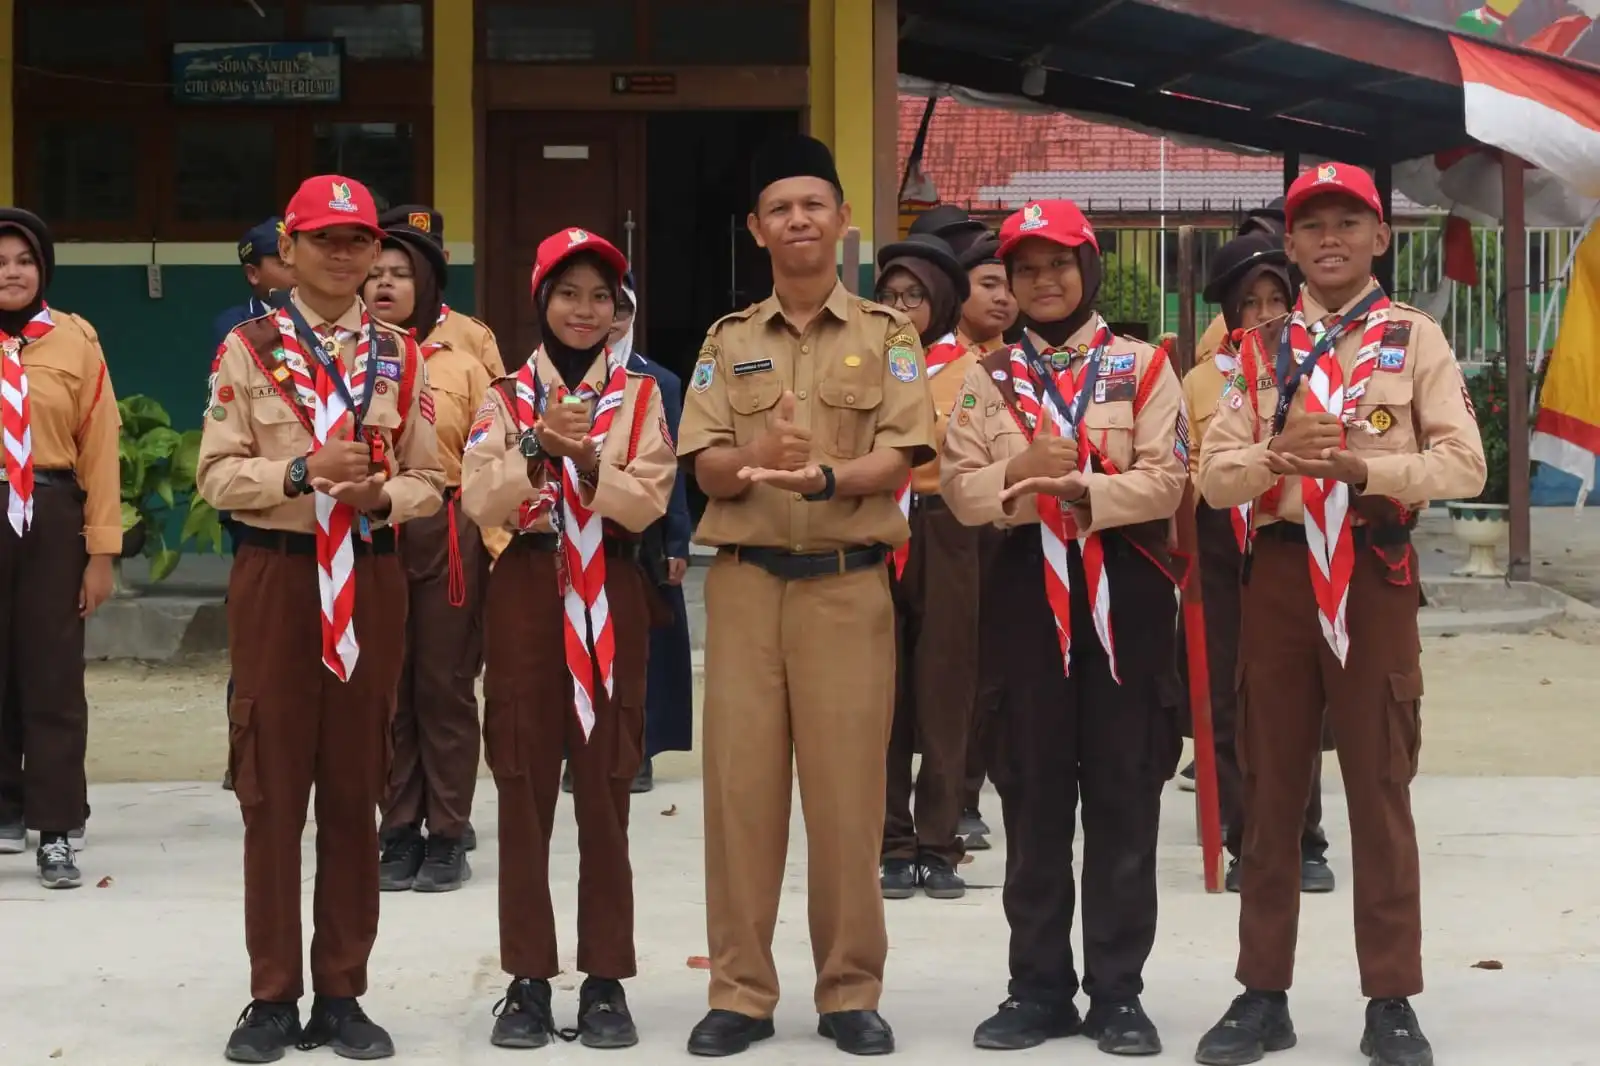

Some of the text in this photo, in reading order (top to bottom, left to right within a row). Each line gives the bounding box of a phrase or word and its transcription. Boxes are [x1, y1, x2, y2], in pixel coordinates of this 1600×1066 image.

[217, 60, 253, 73] SOPAN
[211, 80, 250, 94] ORANG
[252, 80, 280, 94] YANG
[283, 80, 334, 94] BERILMU
